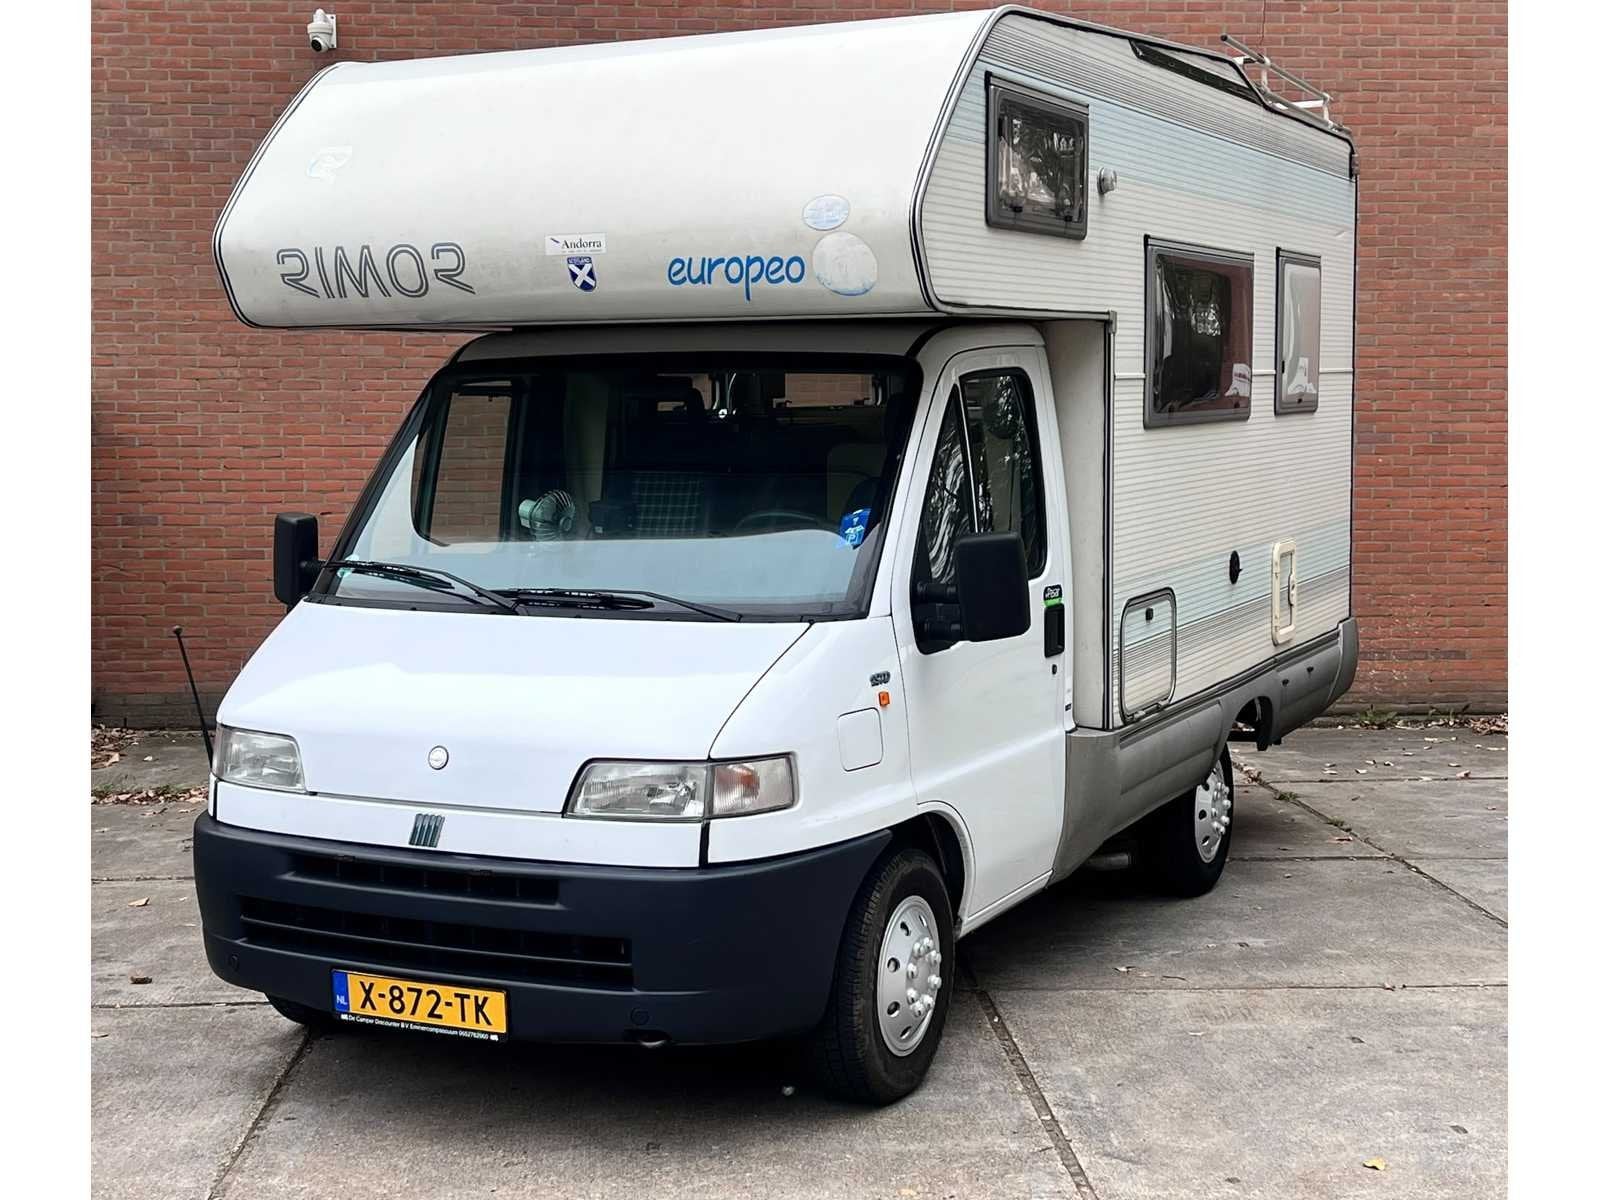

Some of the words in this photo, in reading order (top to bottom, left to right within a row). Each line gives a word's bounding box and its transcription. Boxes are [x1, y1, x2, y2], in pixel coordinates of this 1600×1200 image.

[561, 238, 602, 249] Andorra
[276, 242, 477, 298] RIMOR
[667, 254, 805, 302] europeo
[336, 994, 348, 1005] NL
[359, 980, 493, 1026] X-872-TK
